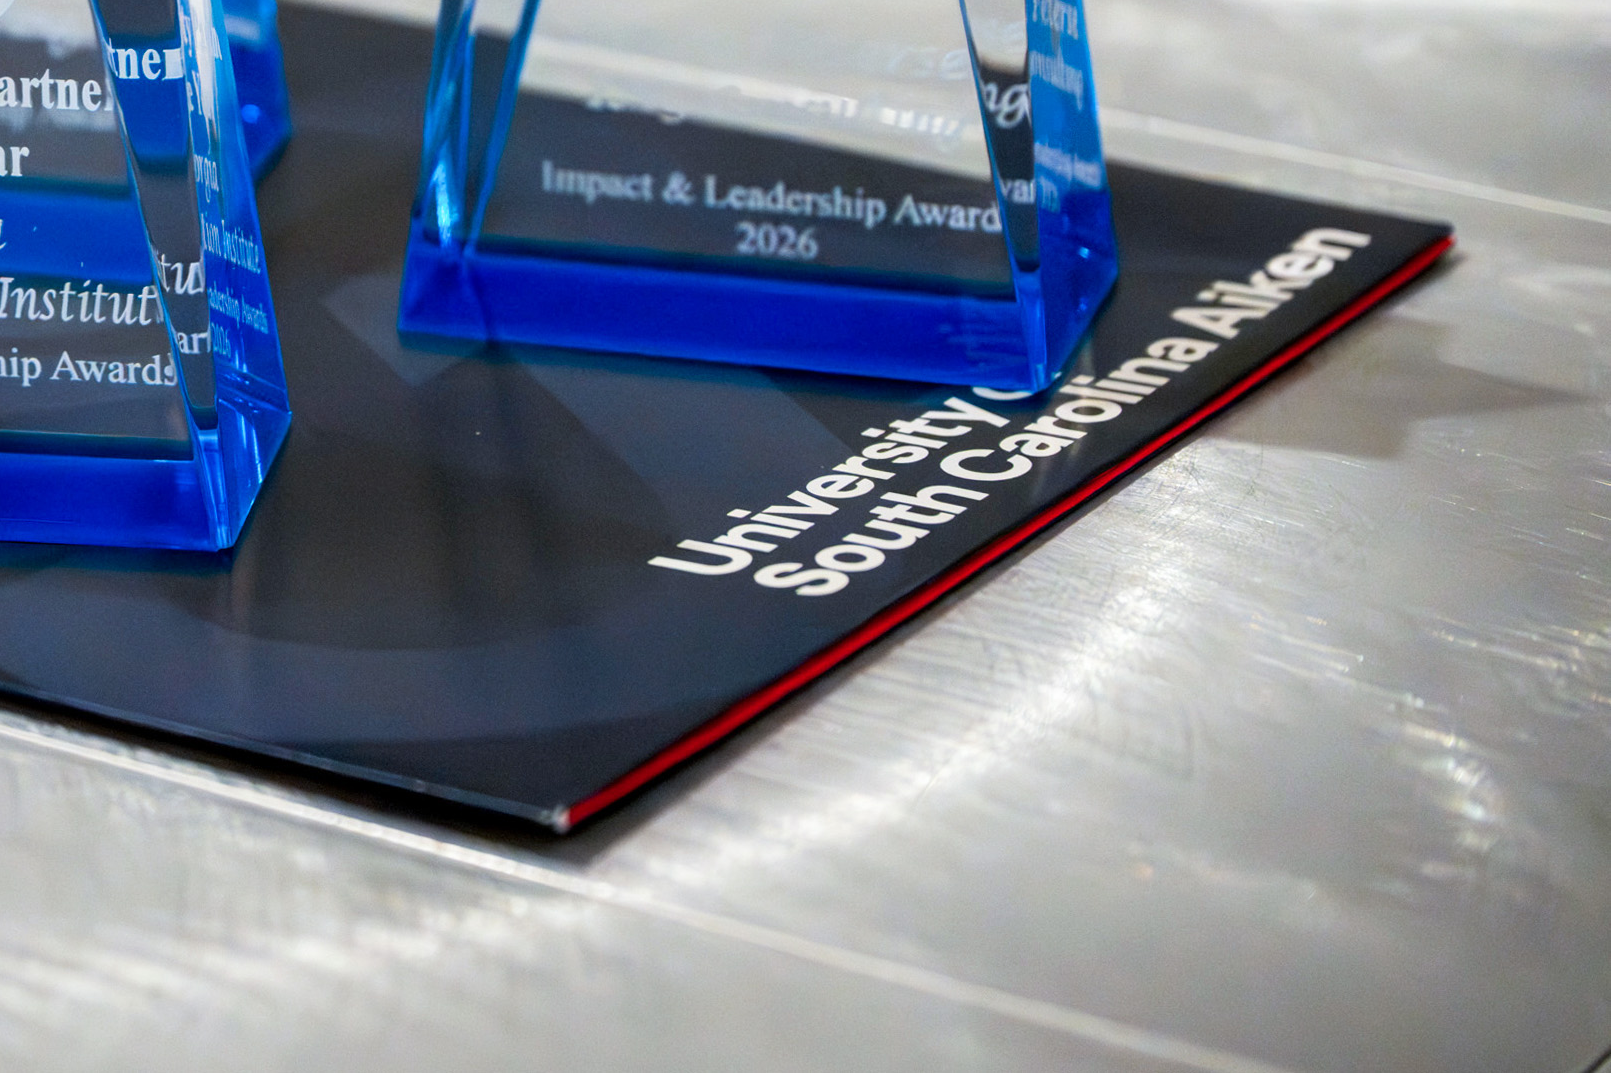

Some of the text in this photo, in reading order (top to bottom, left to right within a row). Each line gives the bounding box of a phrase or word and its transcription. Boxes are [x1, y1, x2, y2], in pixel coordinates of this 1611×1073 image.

[542, 159, 654, 206] Impact
[661, 171, 696, 206] &
[703, 173, 888, 230] Leadership
[893, 193, 1003, 234] Award
[737, 220, 819, 260] 2026
[752, 227, 1372, 597] South Carolina Aiken
[647, 396, 1011, 576] University
